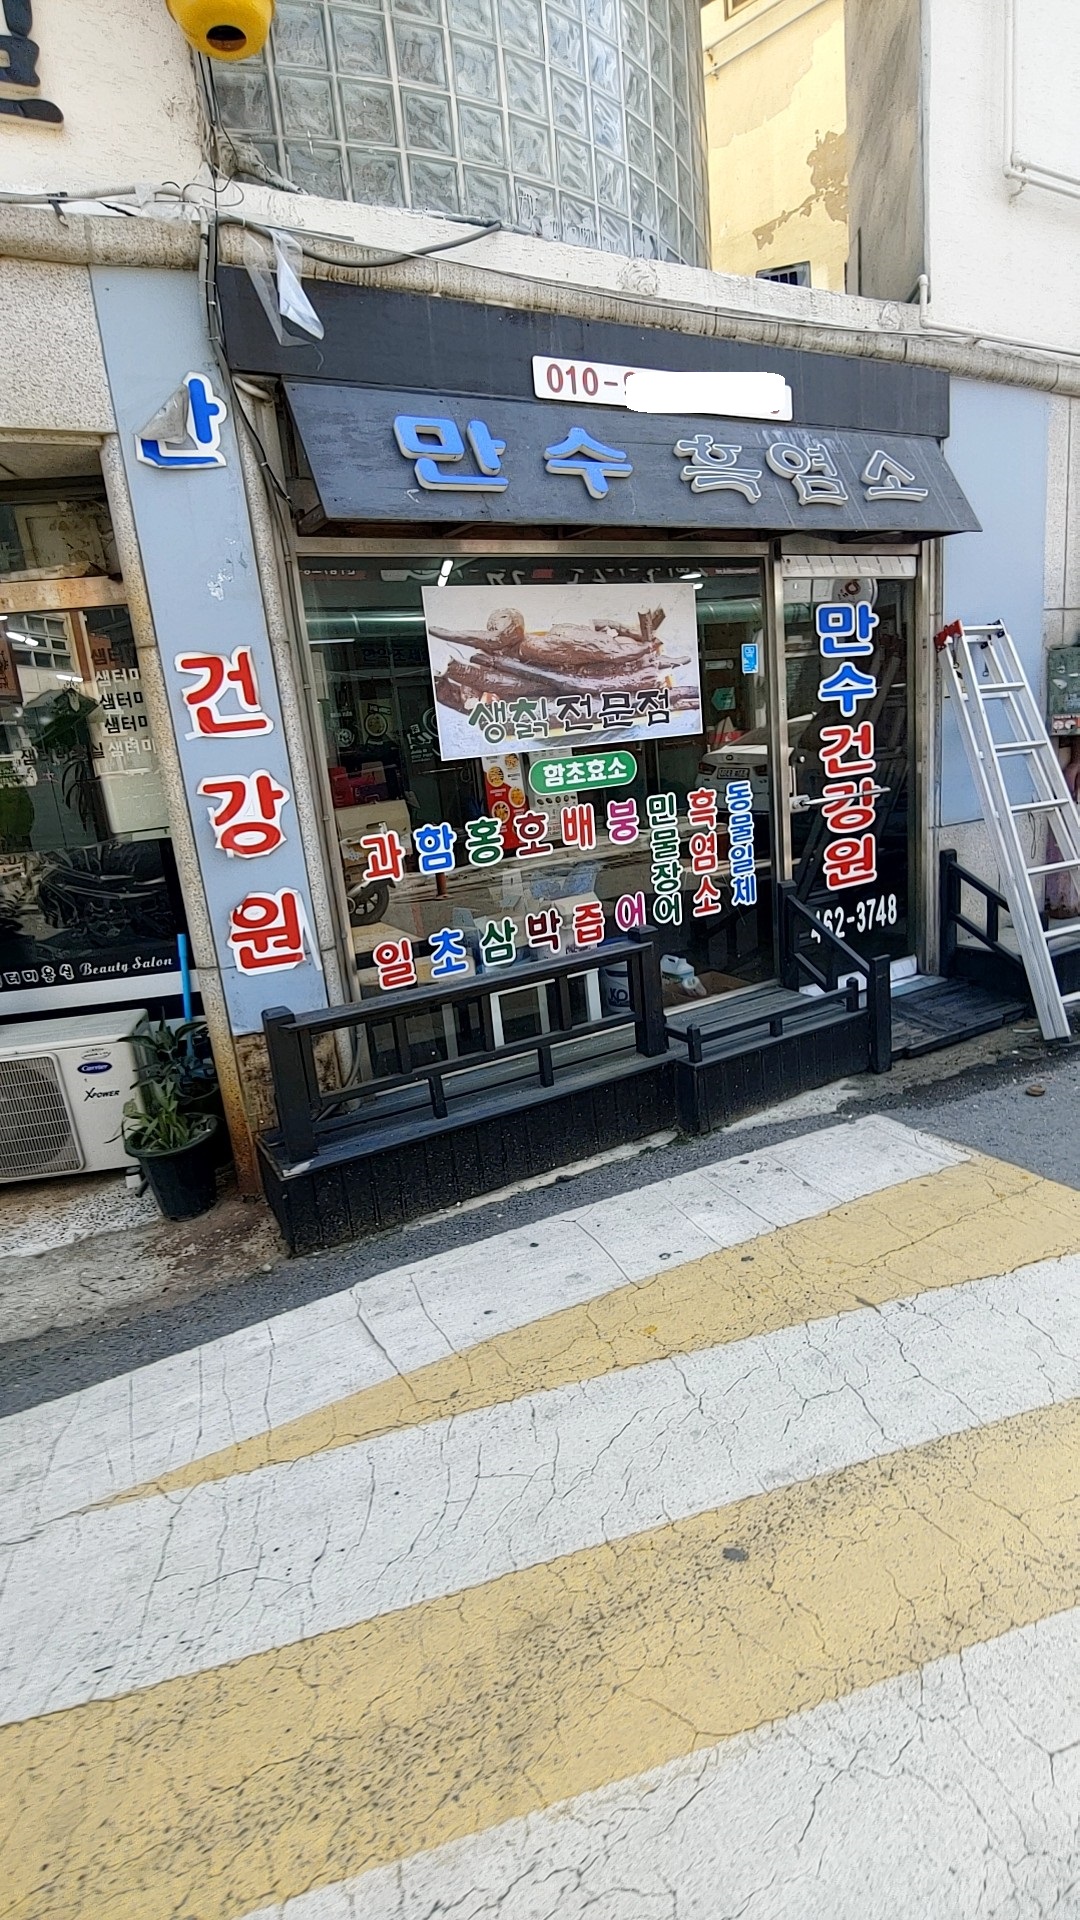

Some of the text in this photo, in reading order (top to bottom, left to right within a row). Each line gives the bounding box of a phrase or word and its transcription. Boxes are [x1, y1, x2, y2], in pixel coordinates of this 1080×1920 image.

[393, 414, 930, 506] 만수 흑염소
[468, 697, 549, 745] 생칡
[556, 687, 671, 733] 전문점
[542, 757, 628, 789] 함초효소
[0, 955, 173, 988] 터미용실 Beauty Salon
